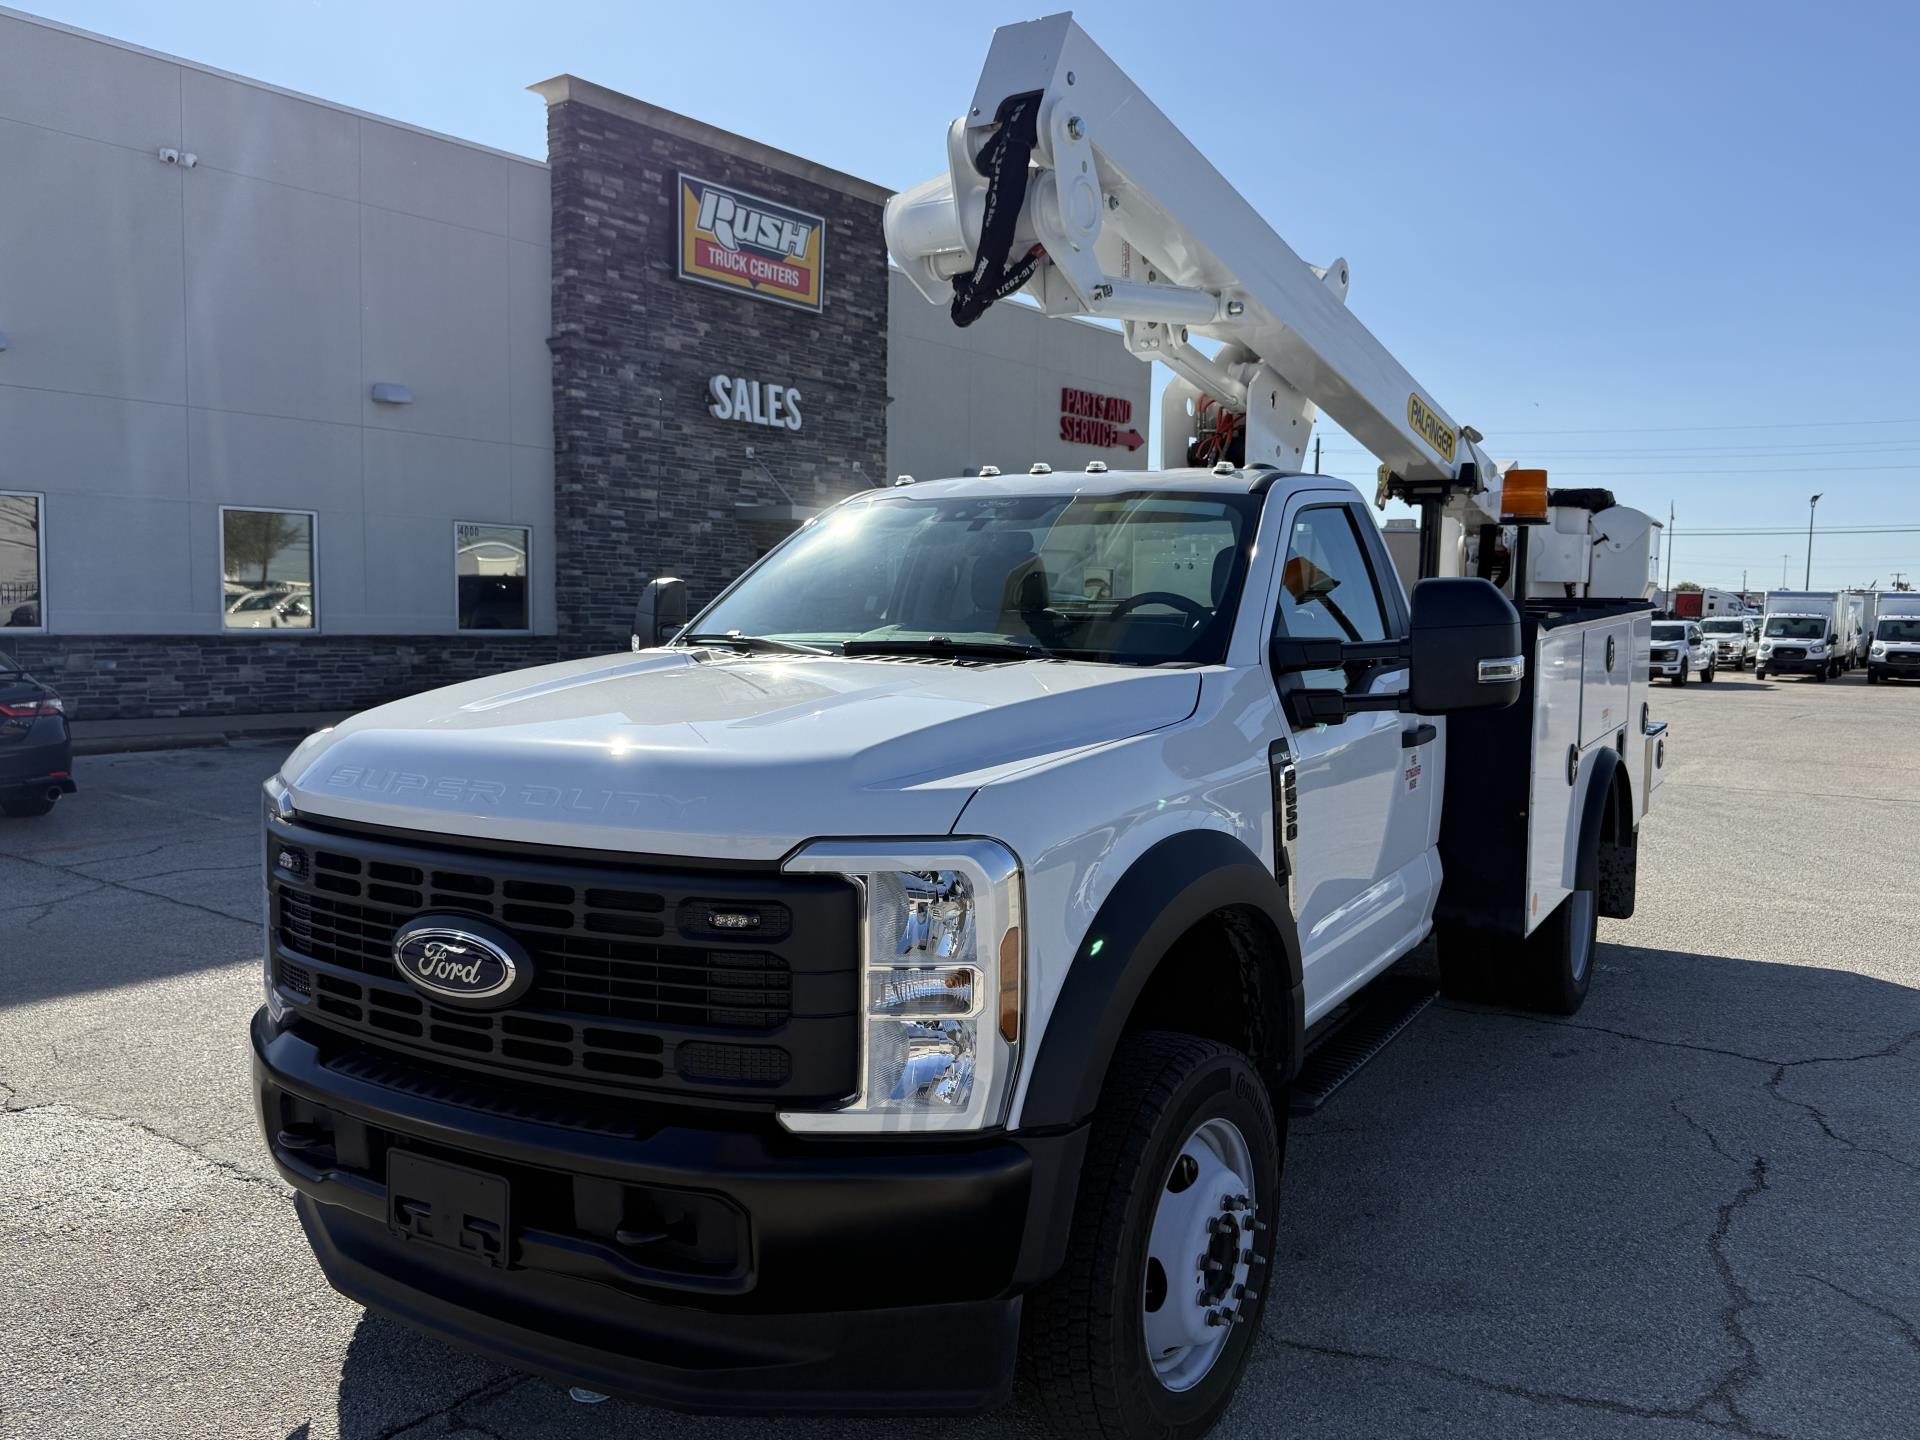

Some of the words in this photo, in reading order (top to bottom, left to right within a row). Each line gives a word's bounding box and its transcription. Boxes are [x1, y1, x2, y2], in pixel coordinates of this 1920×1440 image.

[697, 188, 811, 260] RUSH
[708, 247, 747, 273] TRUCK
[750, 259, 800, 287] CENTERS
[709, 374, 802, 431] SALES
[1061, 387, 1105, 420] PARTS
[1105, 397, 1132, 424] AND
[1060, 415, 1118, 448] SERVICE
[1410, 399, 1453, 458] PALFINGER
[327, 766, 507, 806] SUPER
[520, 784, 708, 818] DUTY
[417, 939, 481, 986] Ford
